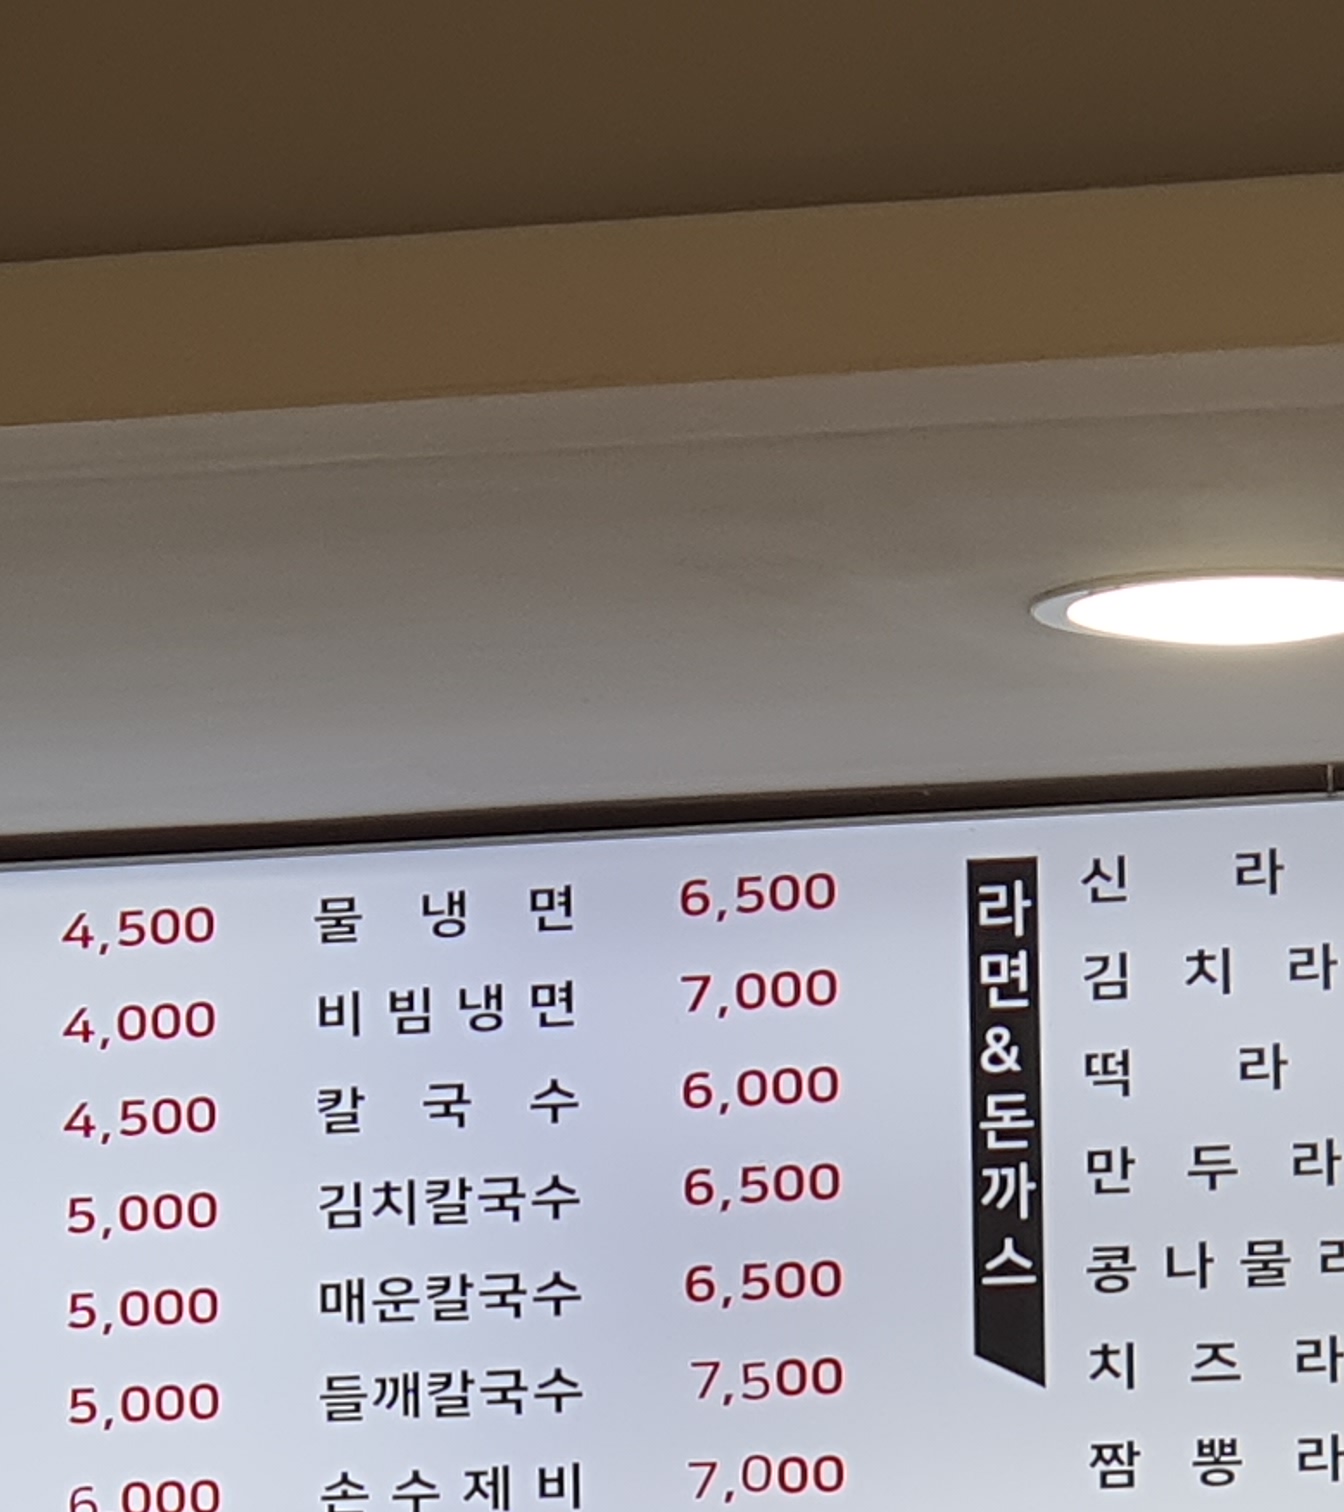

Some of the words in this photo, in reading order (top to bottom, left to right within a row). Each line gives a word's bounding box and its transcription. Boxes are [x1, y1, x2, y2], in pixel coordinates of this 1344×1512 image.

[681, 873, 835, 922] 6,500
[62, 907, 214, 955] 4,500
[681, 969, 837, 1018] 7,000
[63, 1001, 215, 1050] 4,000
[683, 1066, 838, 1115] 6,000
[977, 880, 1037, 1289] 라면&돈까스
[64, 1096, 216, 1145] 4,500
[68, 1192, 217, 1240] 5,000
[320, 1175, 580, 1229] 김치칼국수
[685, 1163, 840, 1212] 6,500
[68, 1288, 218, 1335] 5,000
[320, 1271, 582, 1324] 매운칼국수
[686, 1260, 841, 1309] 6,500
[69, 1383, 219, 1430] 5,000
[320, 1367, 583, 1422] 들깨칼국수
[691, 1357, 842, 1406] 7,500
[688, 1455, 844, 1503] 7,000
